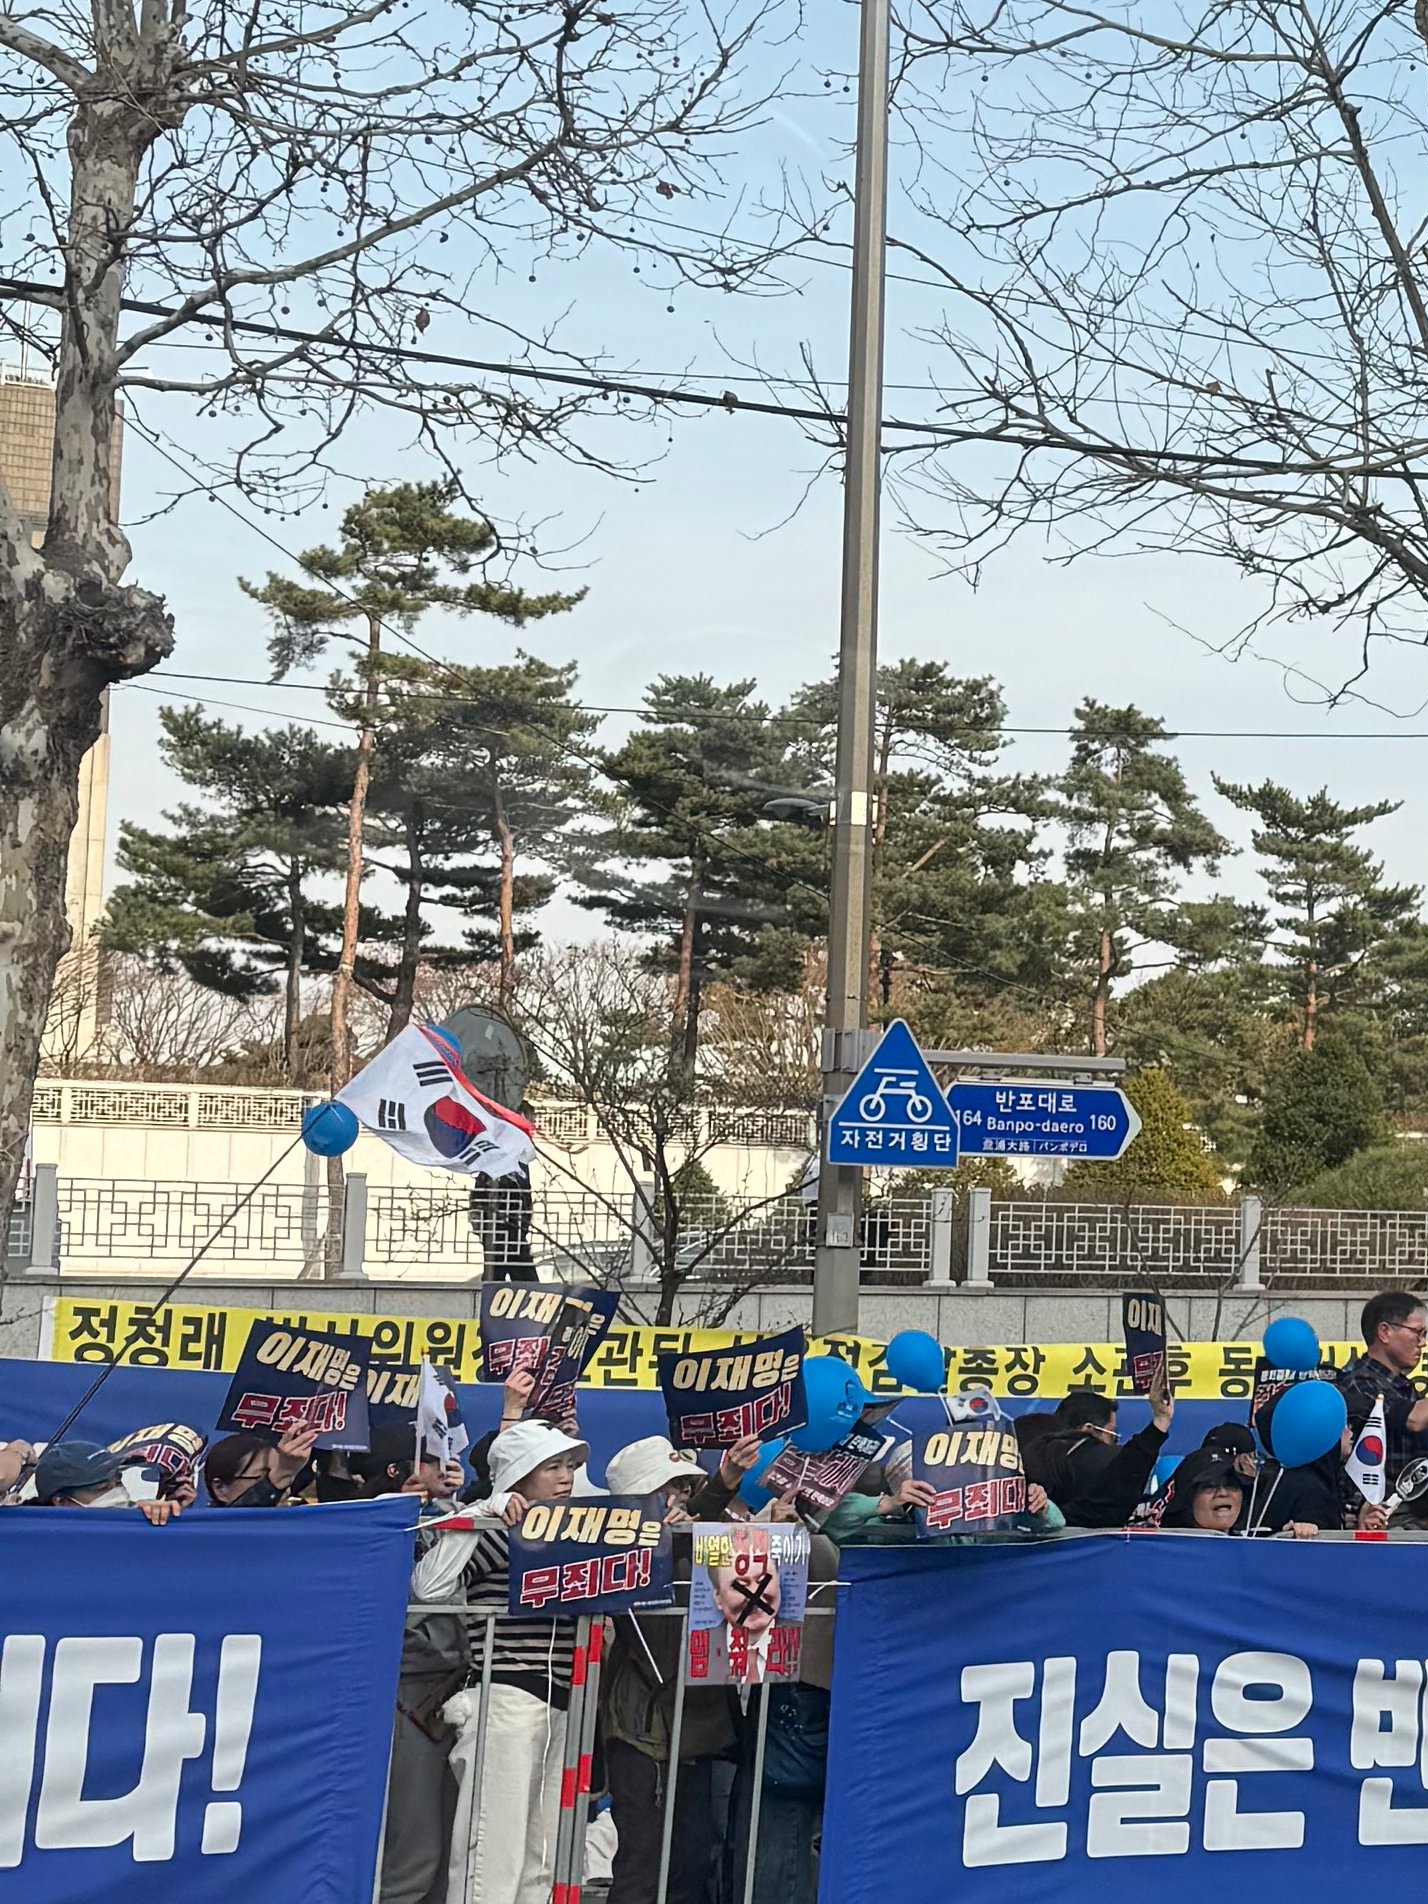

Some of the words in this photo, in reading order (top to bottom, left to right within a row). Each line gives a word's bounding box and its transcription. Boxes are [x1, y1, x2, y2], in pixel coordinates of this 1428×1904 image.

[955, 1109, 982, 1126] 164
[986, 1117, 1085, 1134] Banpo-daero
[1089, 1114, 1116, 1131] 160
[994, 1090, 1078, 1114] 반포대로
[840, 1129, 953, 1152] 자전거횡단
[68, 1304, 228, 1371] 정청래
[255, 1331, 362, 1391] 이재명은
[673, 1348, 800, 1392] 이재명은
[231, 1390, 348, 1434] 무죄다!
[681, 1383, 792, 1444] 무죄다!
[521, 1505, 662, 1547] 이재명은
[520, 1547, 652, 1608] 무죄다!
[955, 1649, 1315, 1868] 진실은
